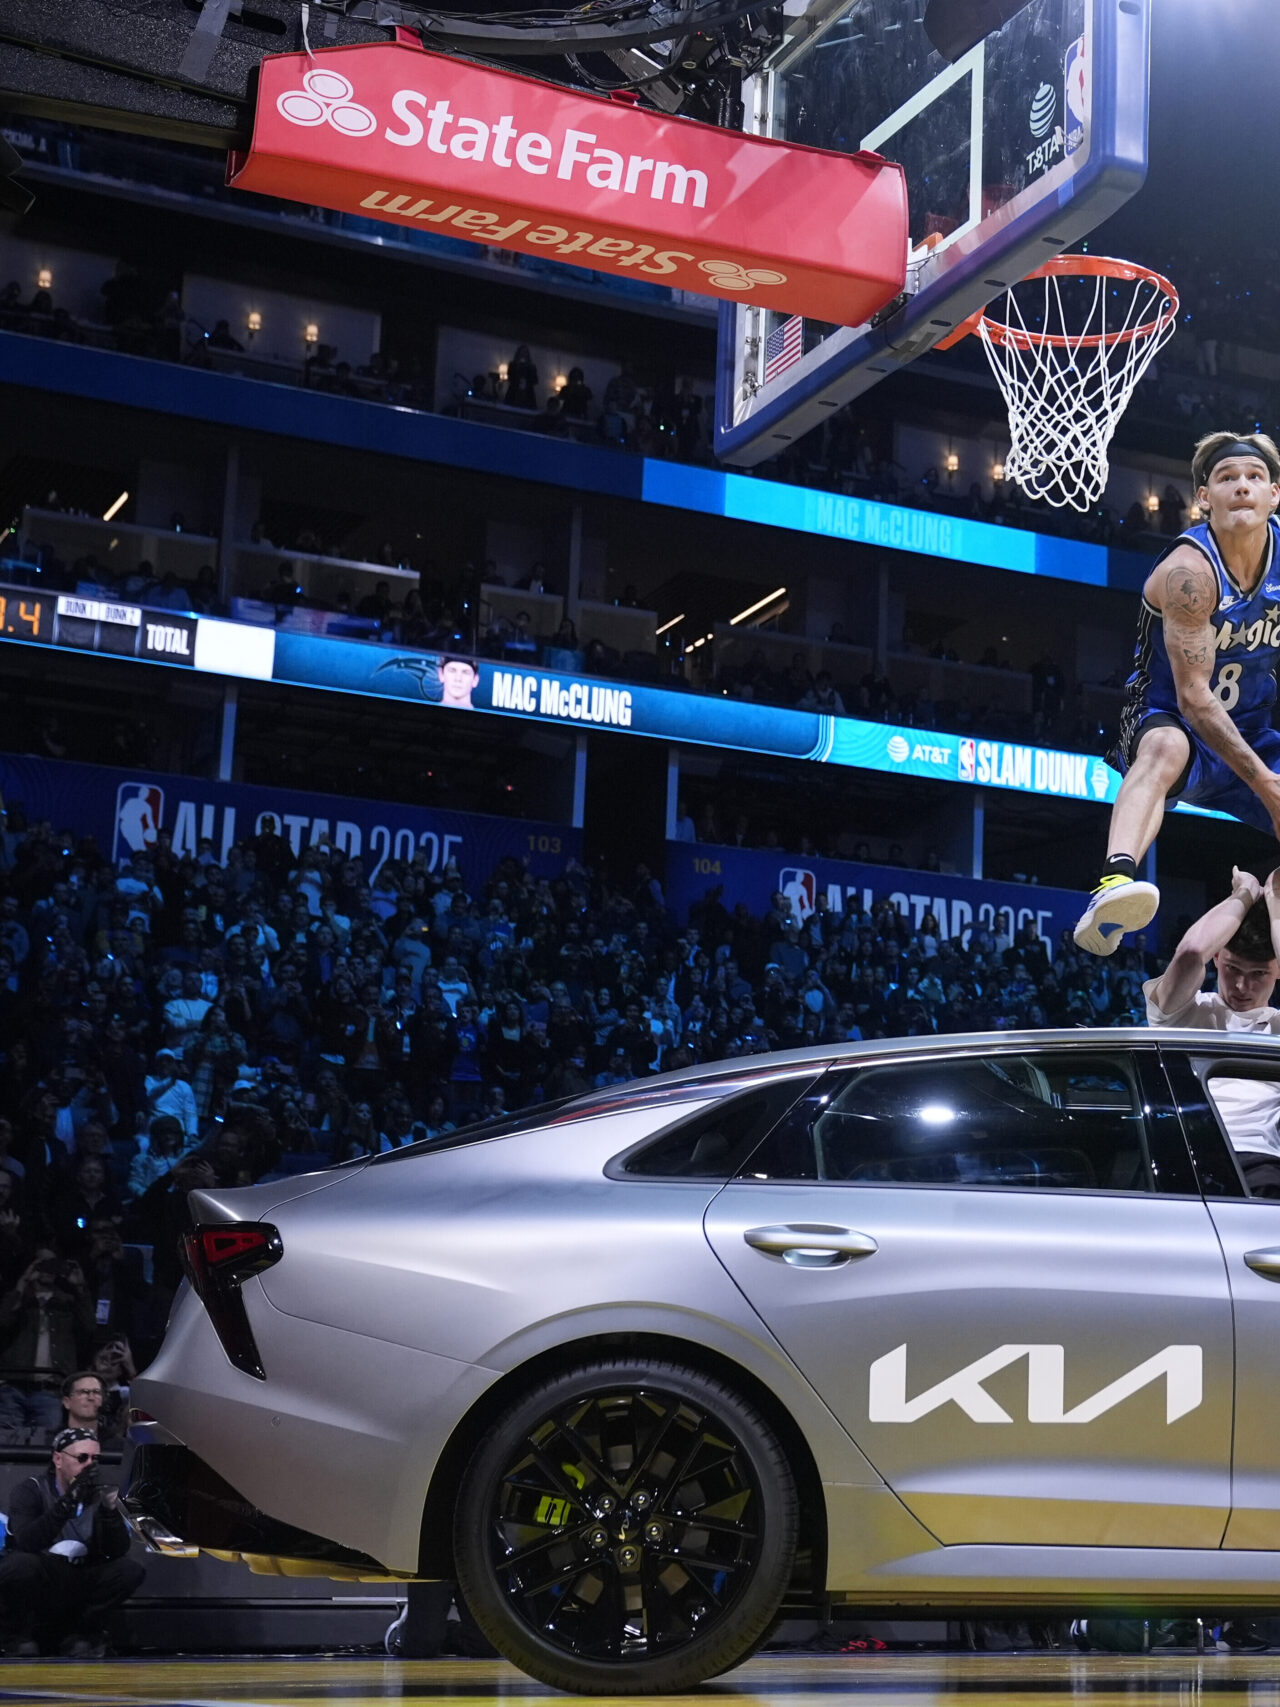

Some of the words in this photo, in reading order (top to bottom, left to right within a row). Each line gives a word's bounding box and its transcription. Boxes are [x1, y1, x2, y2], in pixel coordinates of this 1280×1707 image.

[816, 496, 860, 538] MAC
[864, 505, 951, 555] McCLUNG
[0, 596, 41, 636] .4
[146, 623, 190, 655] TOTAL
[492, 671, 537, 712] MAC
[540, 679, 632, 726] McCLUNG
[1213, 663, 1242, 711] 8
[911, 743, 952, 765] AT&T
[977, 741, 1032, 788] SLAM
[1035, 750, 1088, 796] DUNK
[527, 835, 562, 854] 103
[693, 858, 722, 876] 104
[869, 1343, 1202, 1425] KIA
